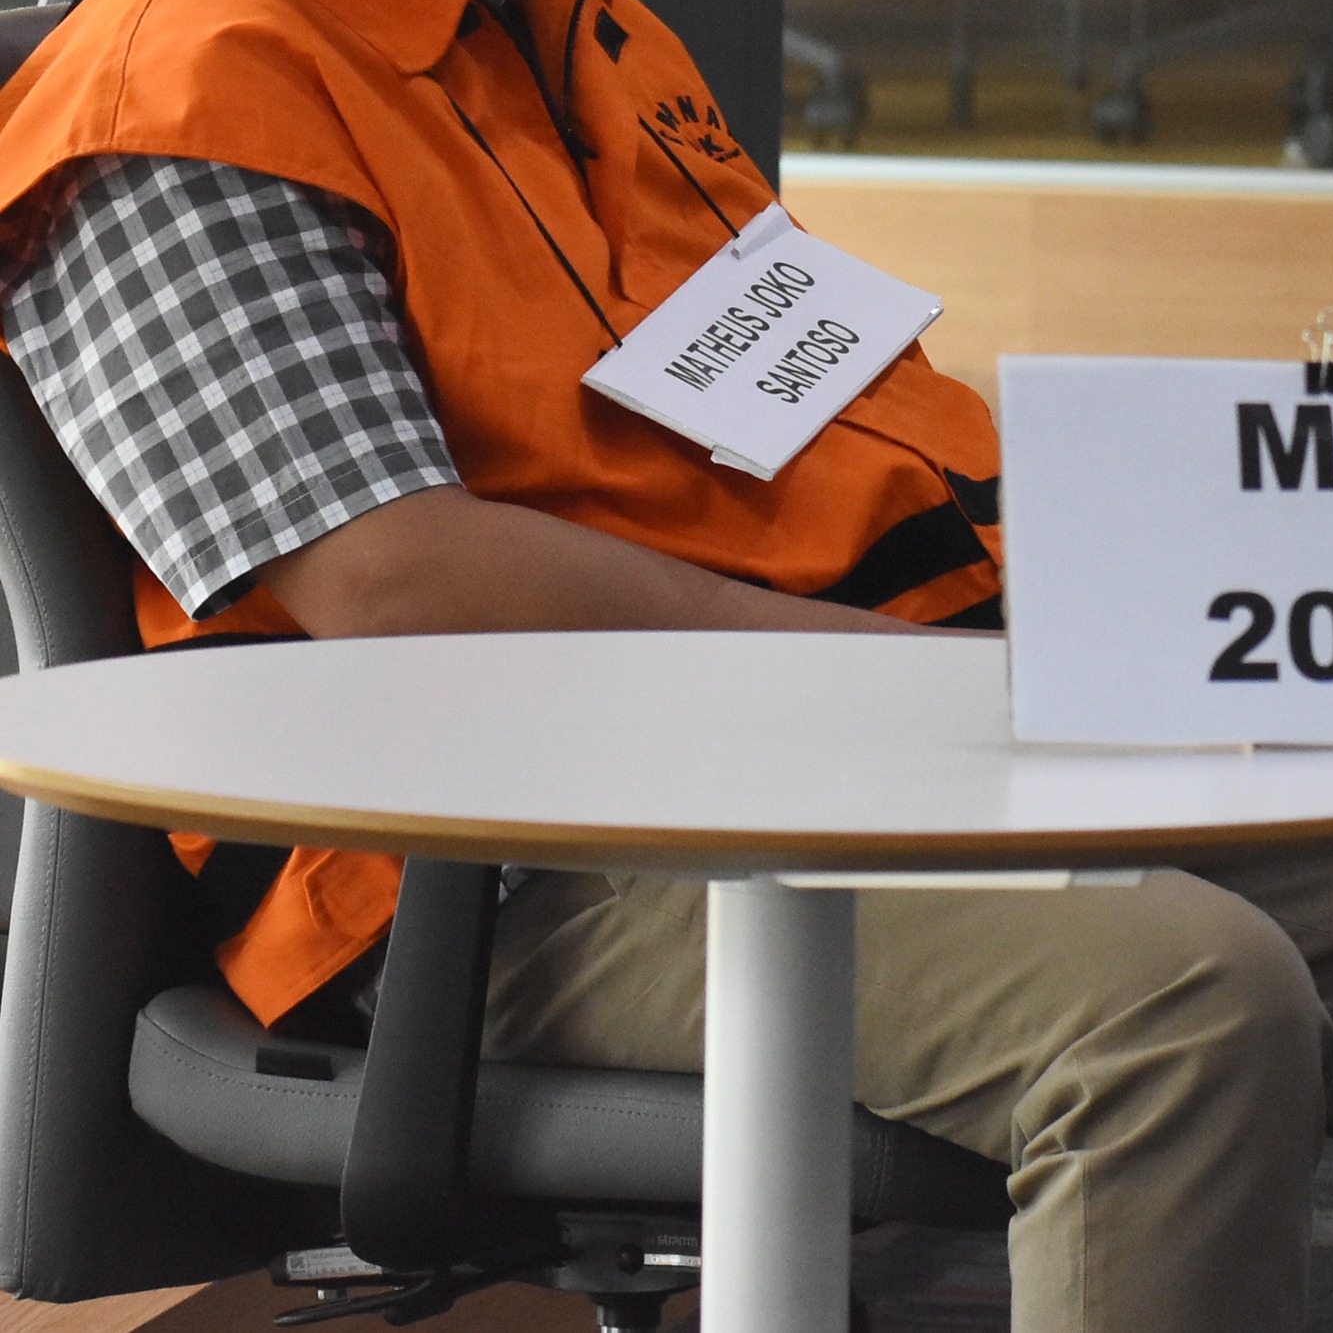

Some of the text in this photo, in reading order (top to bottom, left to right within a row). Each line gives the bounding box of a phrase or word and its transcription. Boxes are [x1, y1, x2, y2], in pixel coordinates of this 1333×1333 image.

[664, 261, 816, 392] MATHEUS JOKO
[755, 319, 861, 404] SANTOSO
